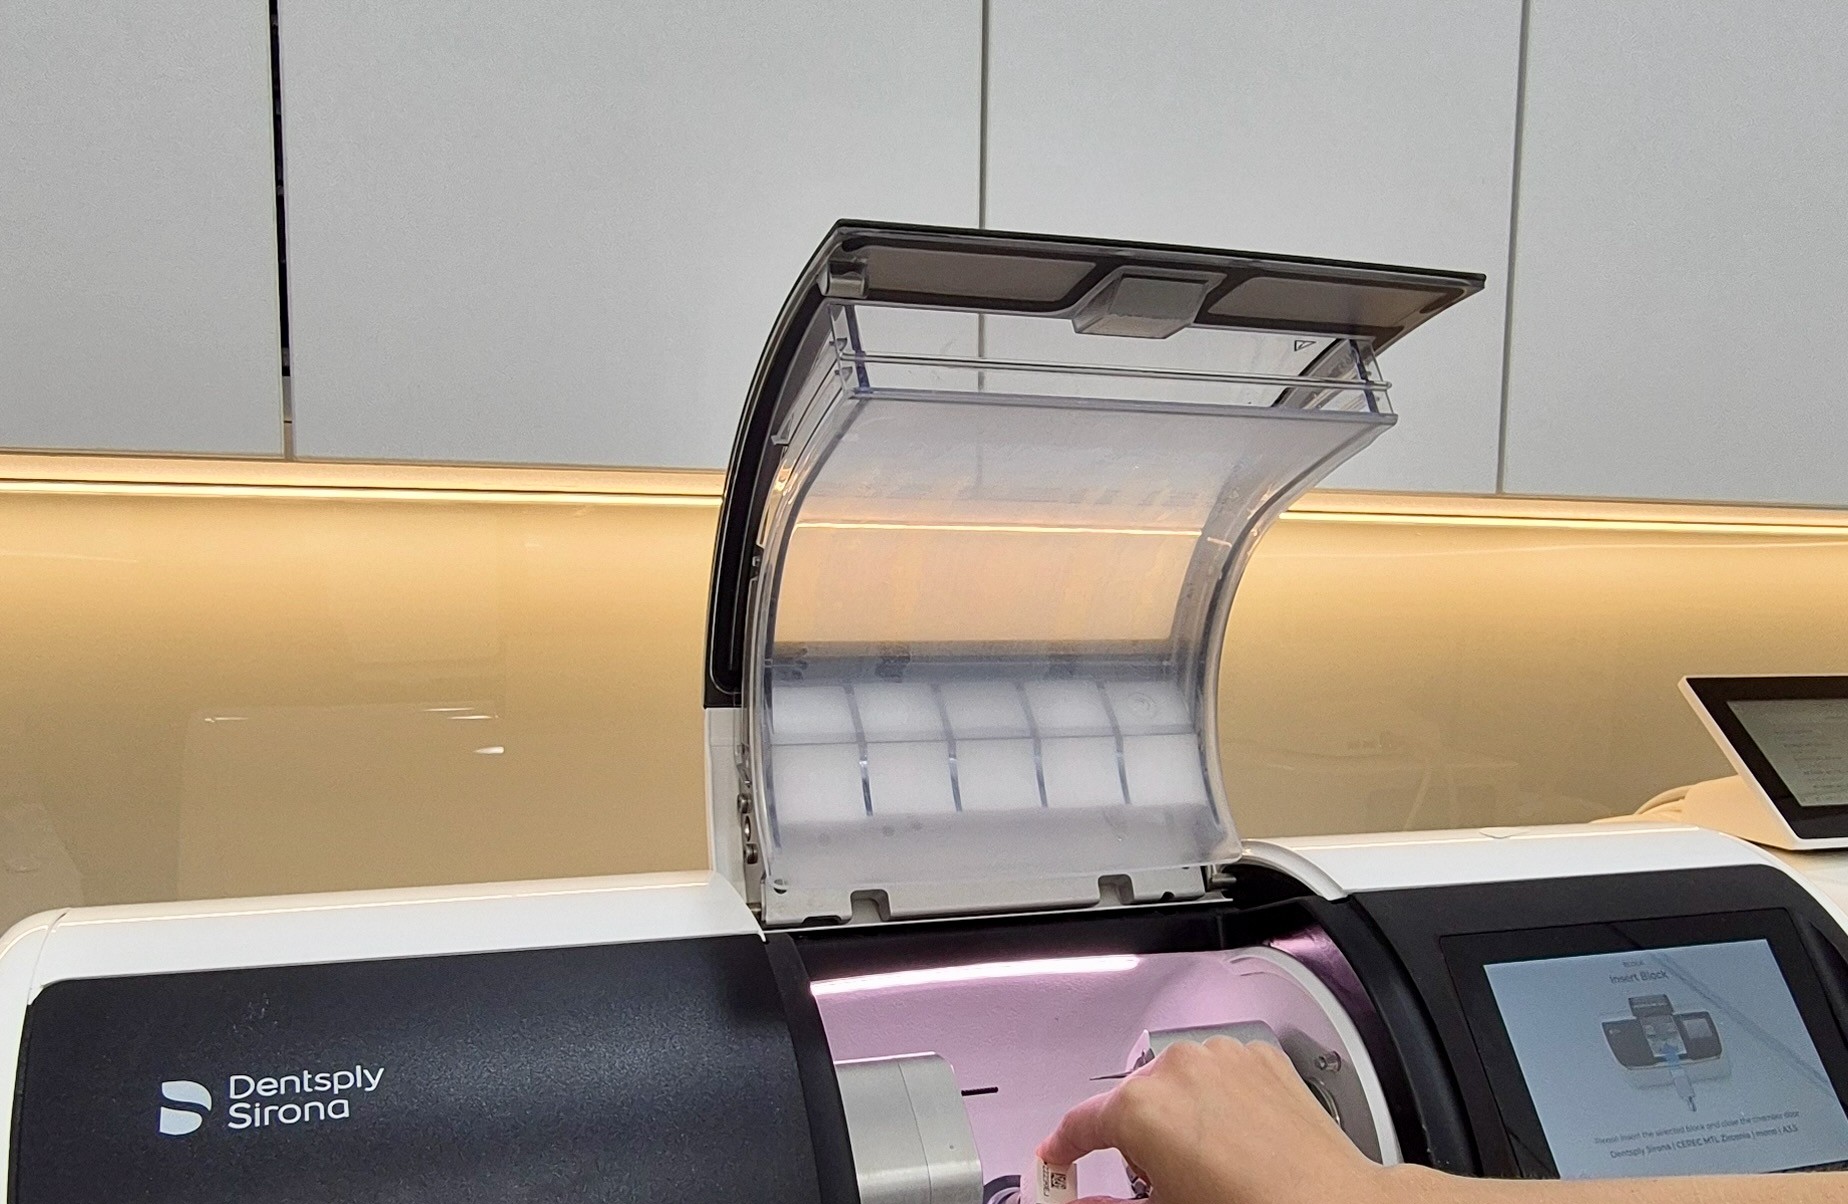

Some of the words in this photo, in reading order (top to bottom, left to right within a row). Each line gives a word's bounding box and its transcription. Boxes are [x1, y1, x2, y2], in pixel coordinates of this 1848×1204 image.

[1609, 973, 1640, 984] Insert
[1640, 970, 1669, 981] Block
[229, 1065, 385, 1100] Dentsply
[227, 1098, 350, 1130] Sirona
[1610, 1147, 1645, 1158] Dentsply
[1645, 1143, 1671, 1154] Sirona
[1676, 1138, 1703, 1148] CEREC
[1703, 1135, 1719, 1144] MTL
[1720, 1132, 1751, 1142] Zirconia
